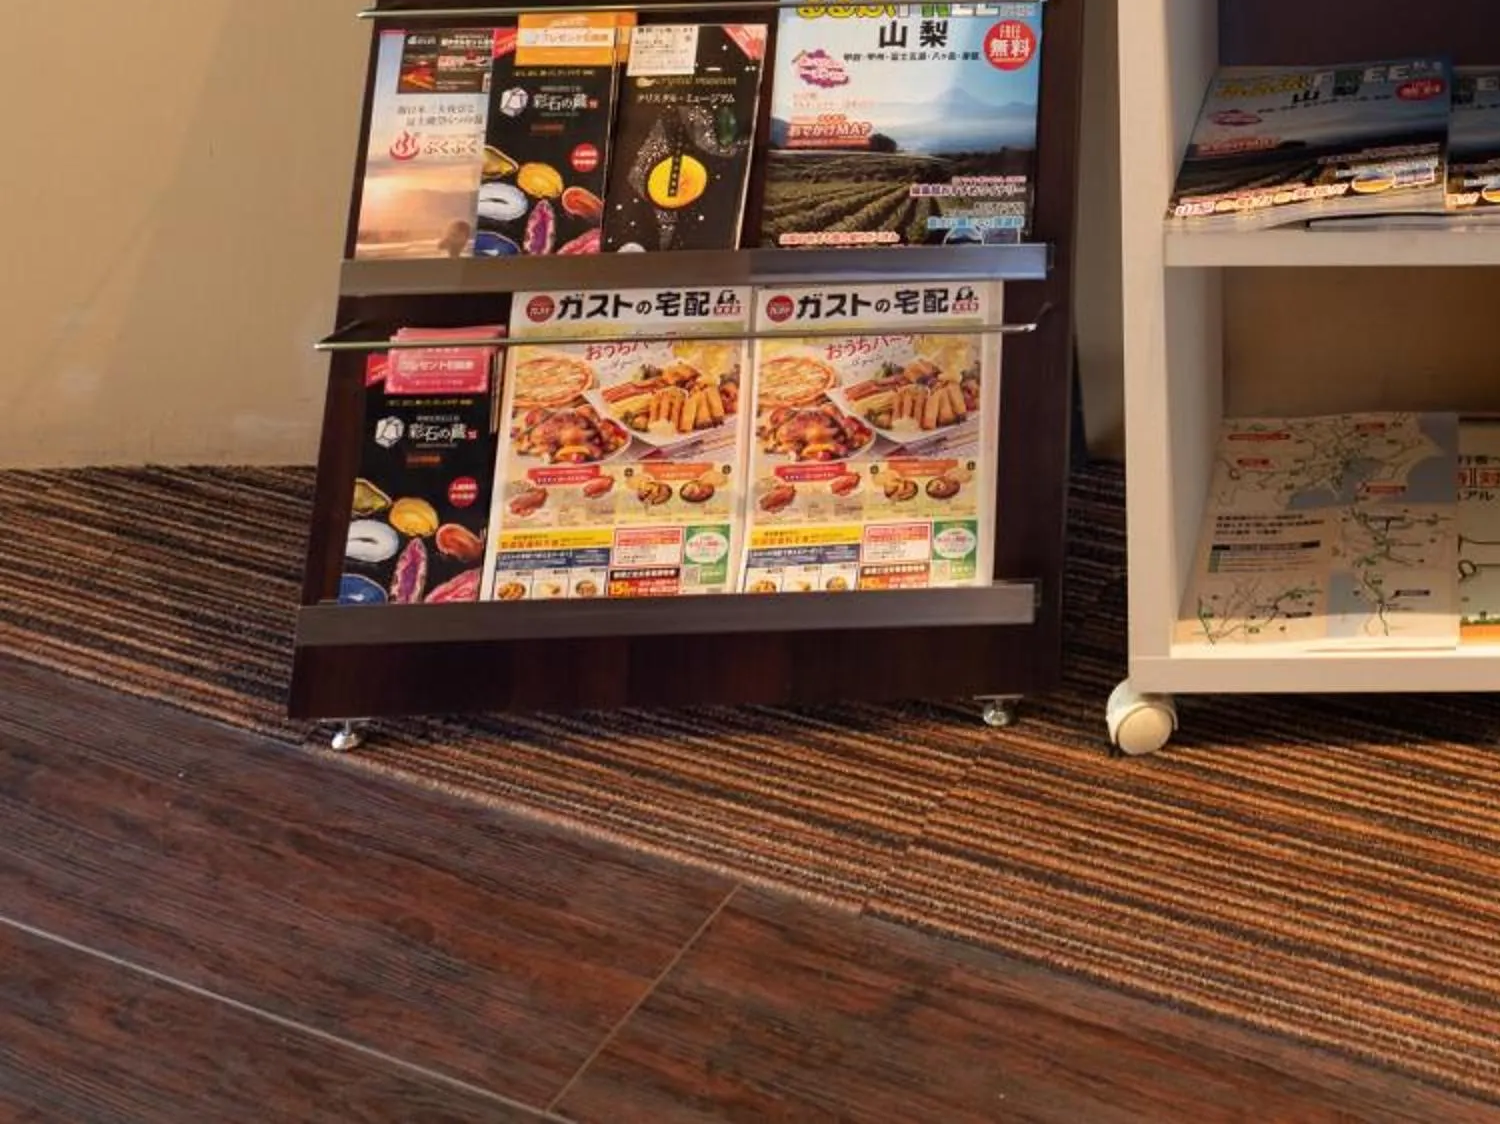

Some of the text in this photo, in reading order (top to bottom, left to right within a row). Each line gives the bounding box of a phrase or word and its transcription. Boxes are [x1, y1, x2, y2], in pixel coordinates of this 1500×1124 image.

[878, 20, 949, 49] 山梨
[989, 38, 1030, 59] 無料
[557, 289, 711, 320] ガストの宅配
[796, 287, 949, 319] ガストの宅配
